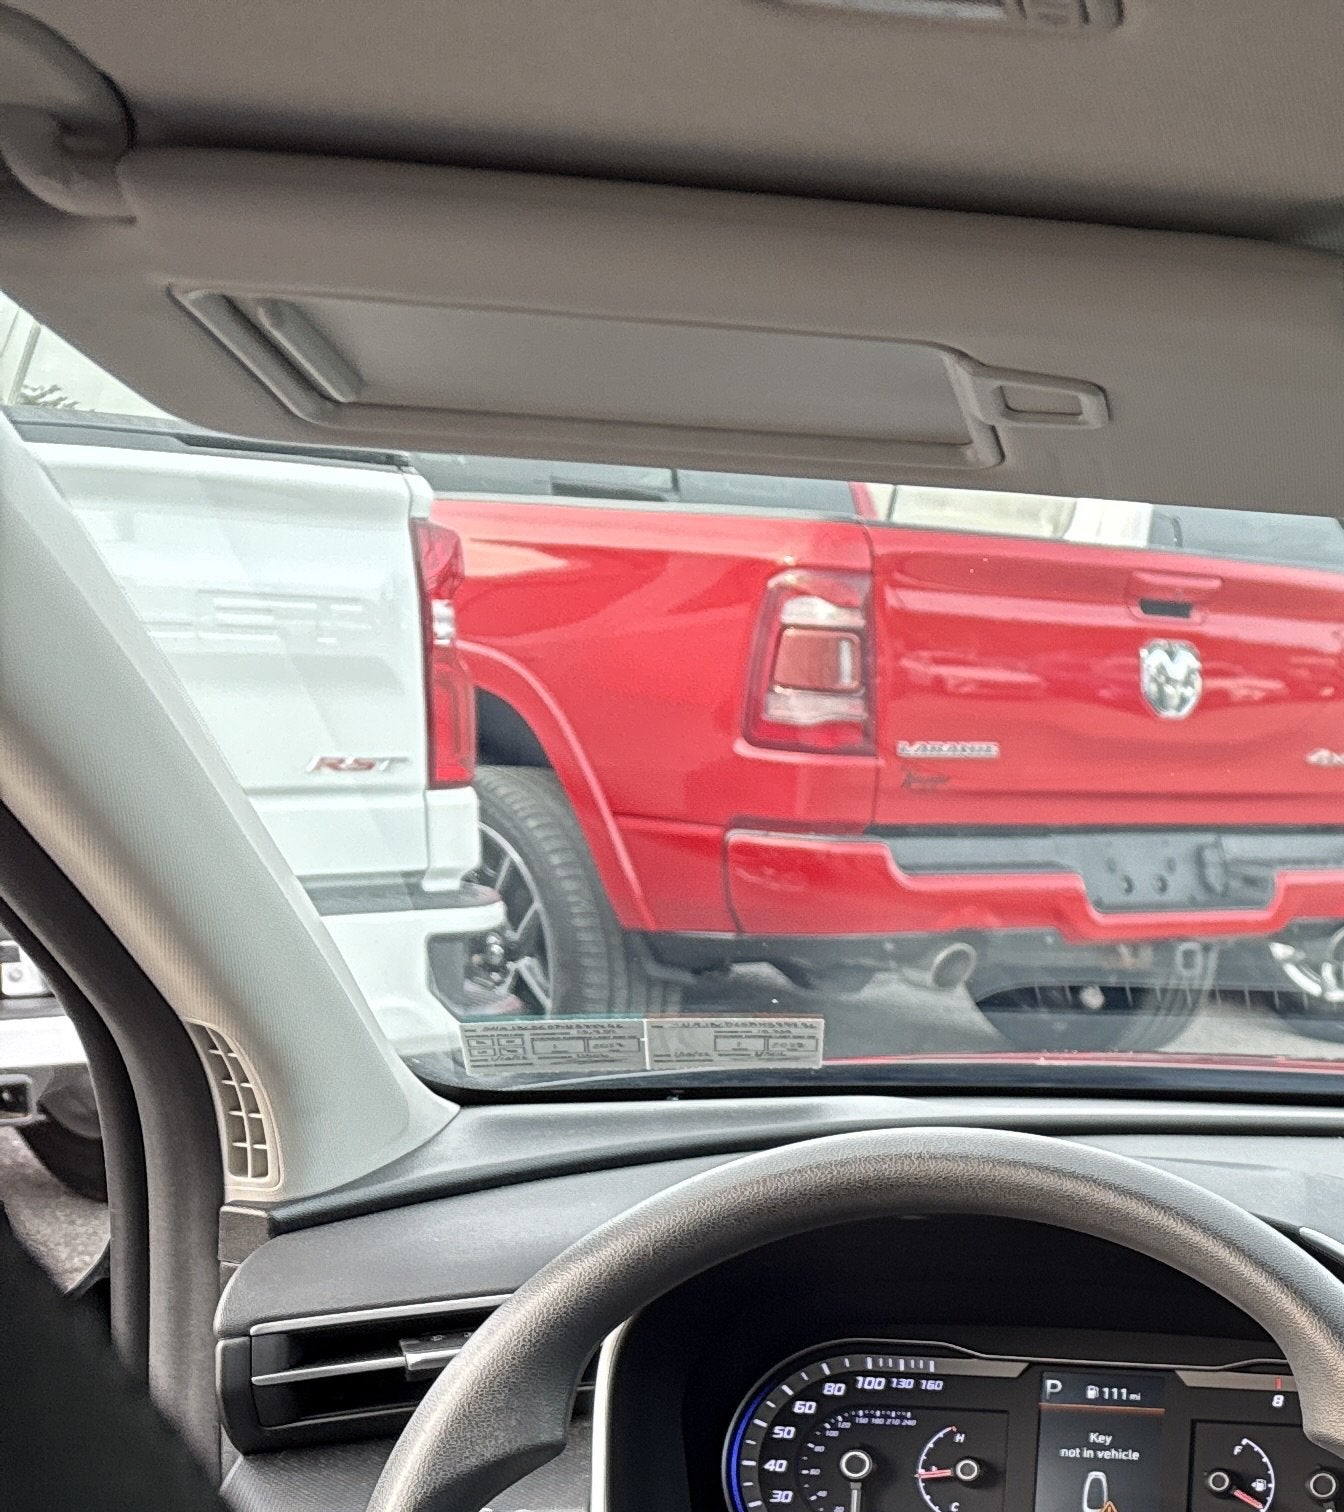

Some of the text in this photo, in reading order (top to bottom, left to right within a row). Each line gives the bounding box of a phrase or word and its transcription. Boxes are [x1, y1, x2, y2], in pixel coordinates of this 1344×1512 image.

[822, 1382, 847, 1396] 80
[855, 1376, 886, 1391] 100
[890, 1377, 915, 1389] 130
[919, 1379, 944, 1391] 160
[1045, 1379, 1062, 1399] P
[1102, 1387, 1127, 1400] 111
[793, 1401, 817, 1414] 60
[1271, 1394, 1285, 1408] 8
[772, 1426, 796, 1439] 50
[954, 1433, 965, 1443] H
[1089, 1432, 1112, 1445] Key
[1059, 1447, 1140, 1461] not in vehicle
[1233, 1446, 1242, 1455] F
[763, 1459, 788, 1472] 40
[769, 1490, 793, 1503] 30
[950, 1502, 960, 1512] C
